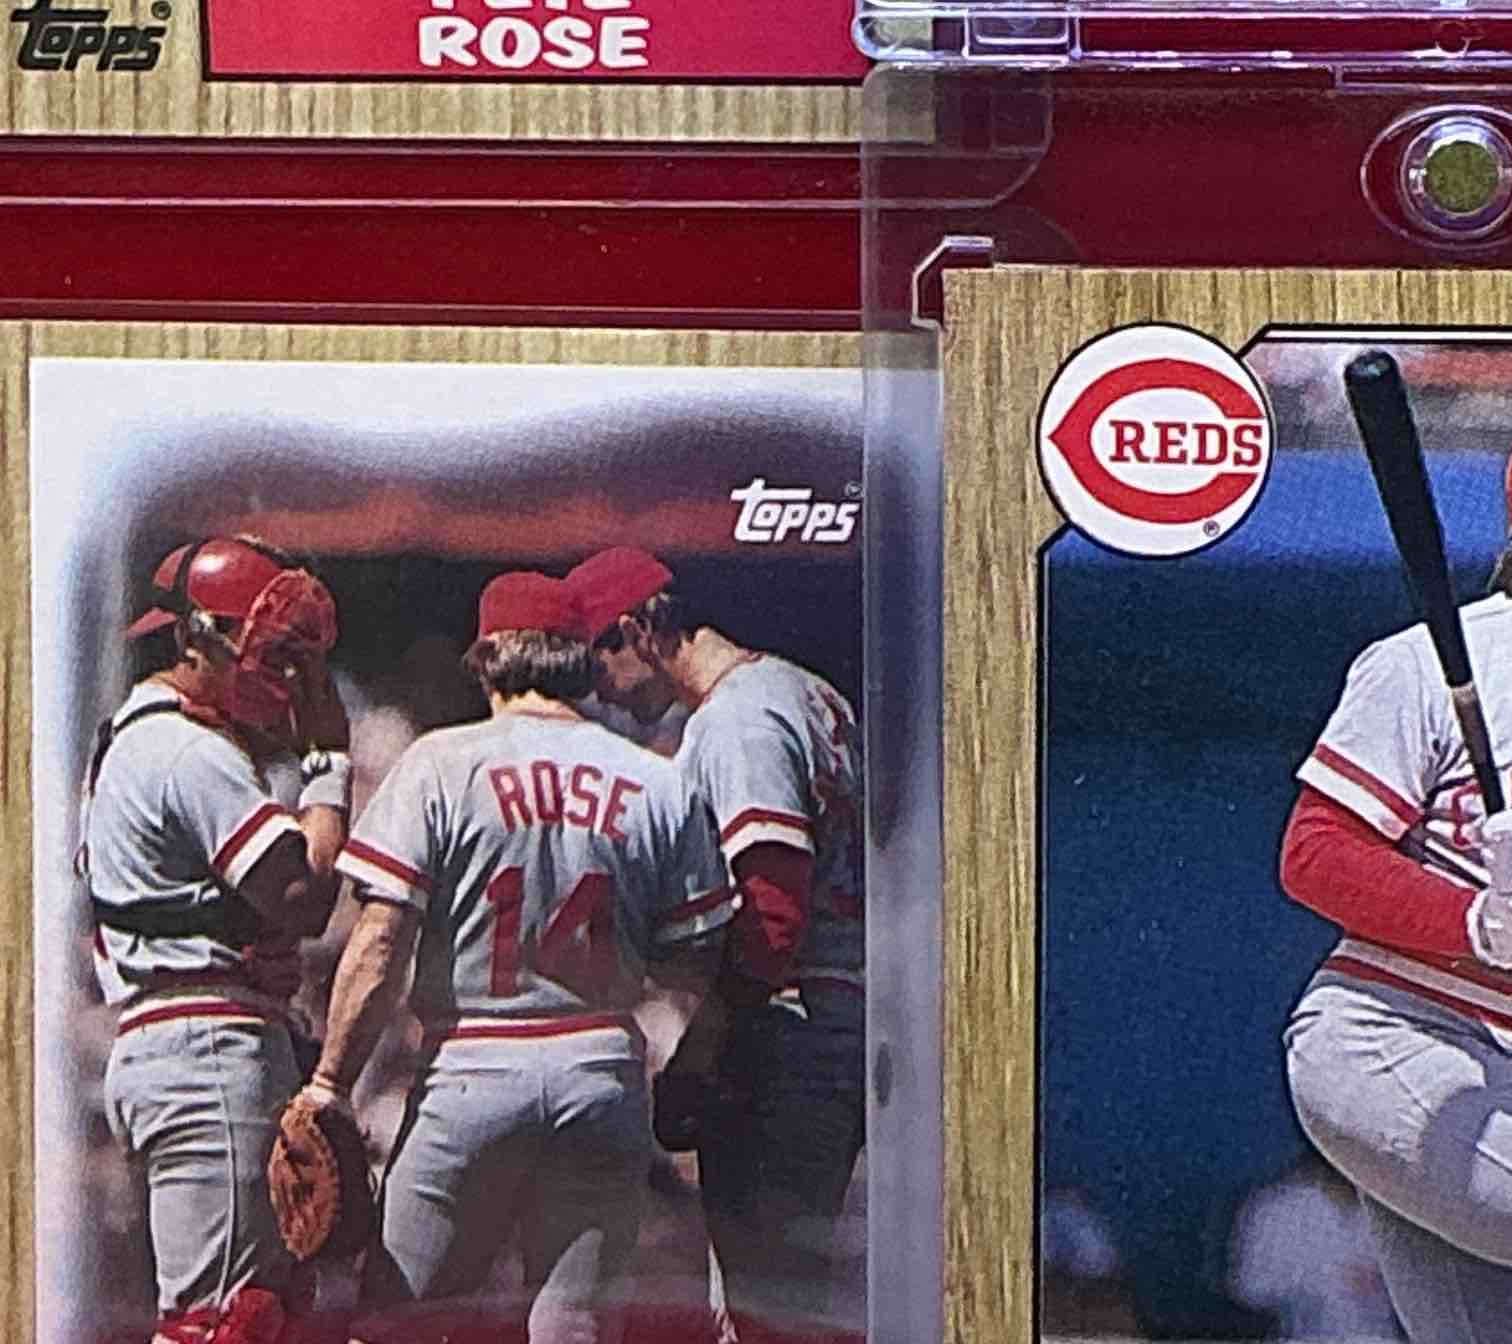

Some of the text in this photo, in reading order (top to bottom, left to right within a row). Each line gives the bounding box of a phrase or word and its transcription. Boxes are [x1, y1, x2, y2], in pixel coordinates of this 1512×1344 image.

[419, 16, 650, 69] ROSE
[1109, 420, 1263, 467] REDS
[489, 759, 644, 845] ROSE
[486, 864, 616, 1002] 14
